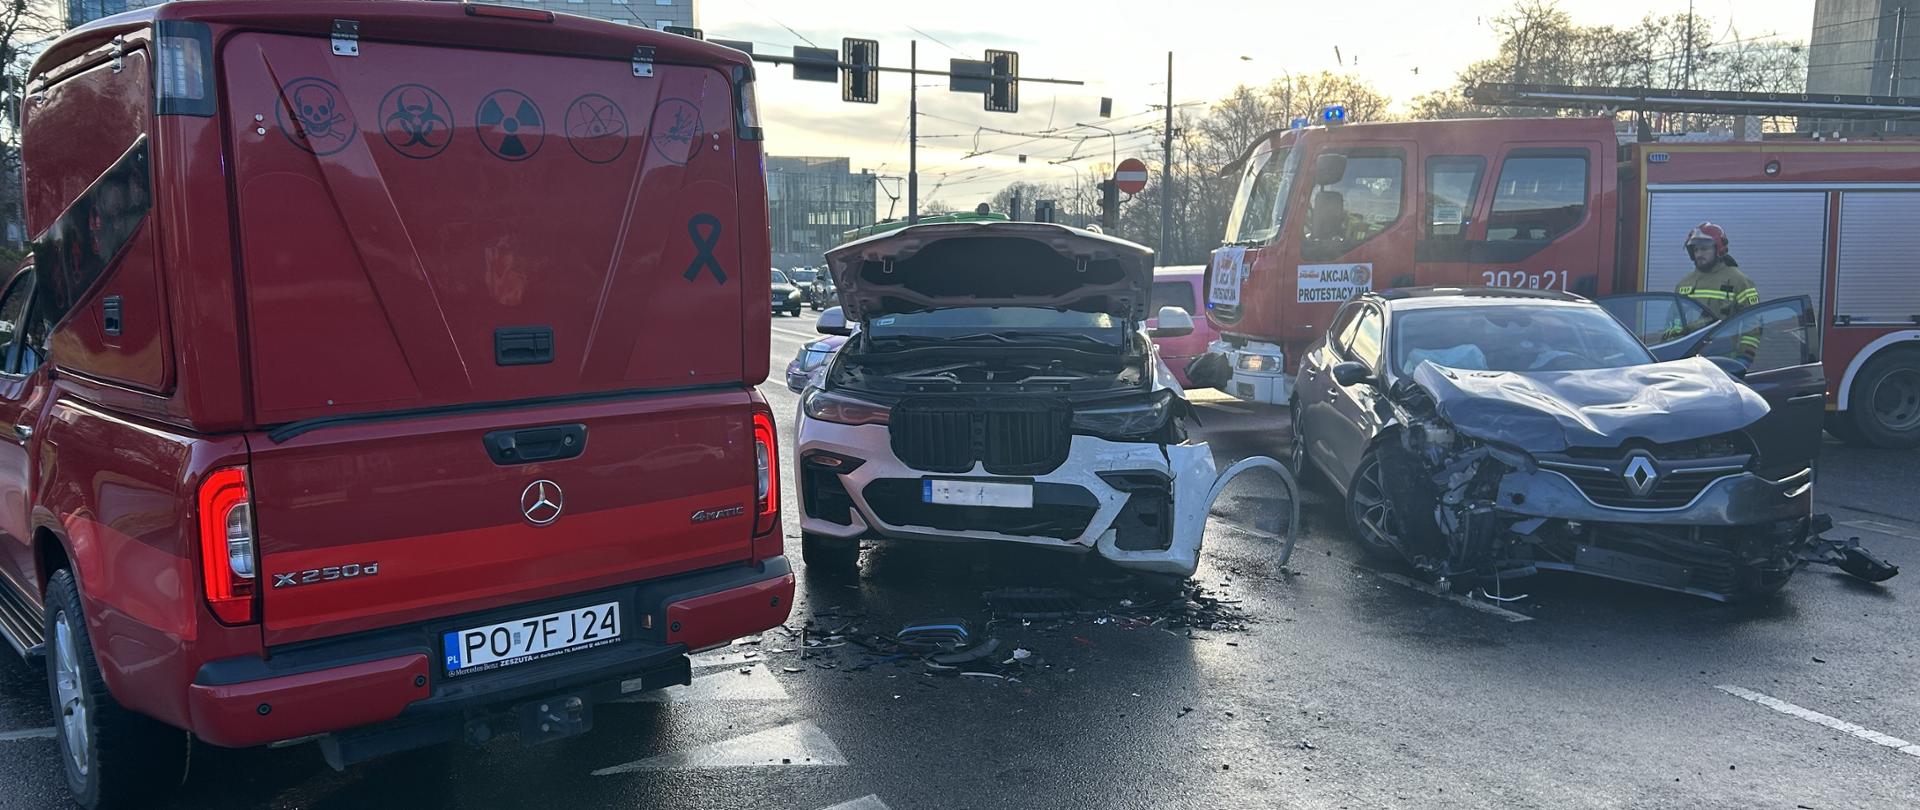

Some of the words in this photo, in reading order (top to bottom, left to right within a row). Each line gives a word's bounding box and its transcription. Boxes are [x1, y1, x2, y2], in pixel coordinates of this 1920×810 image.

[1320, 269, 1349, 282] AKCJA
[1482, 270, 1526, 288] 302
[1543, 270, 1568, 291] 21
[274, 572, 297, 587] X
[465, 627, 511, 664] PO
[523, 606, 616, 652] 7FJ24
[447, 656, 459, 664] PL
[500, 655, 533, 667] ZESZUTA
